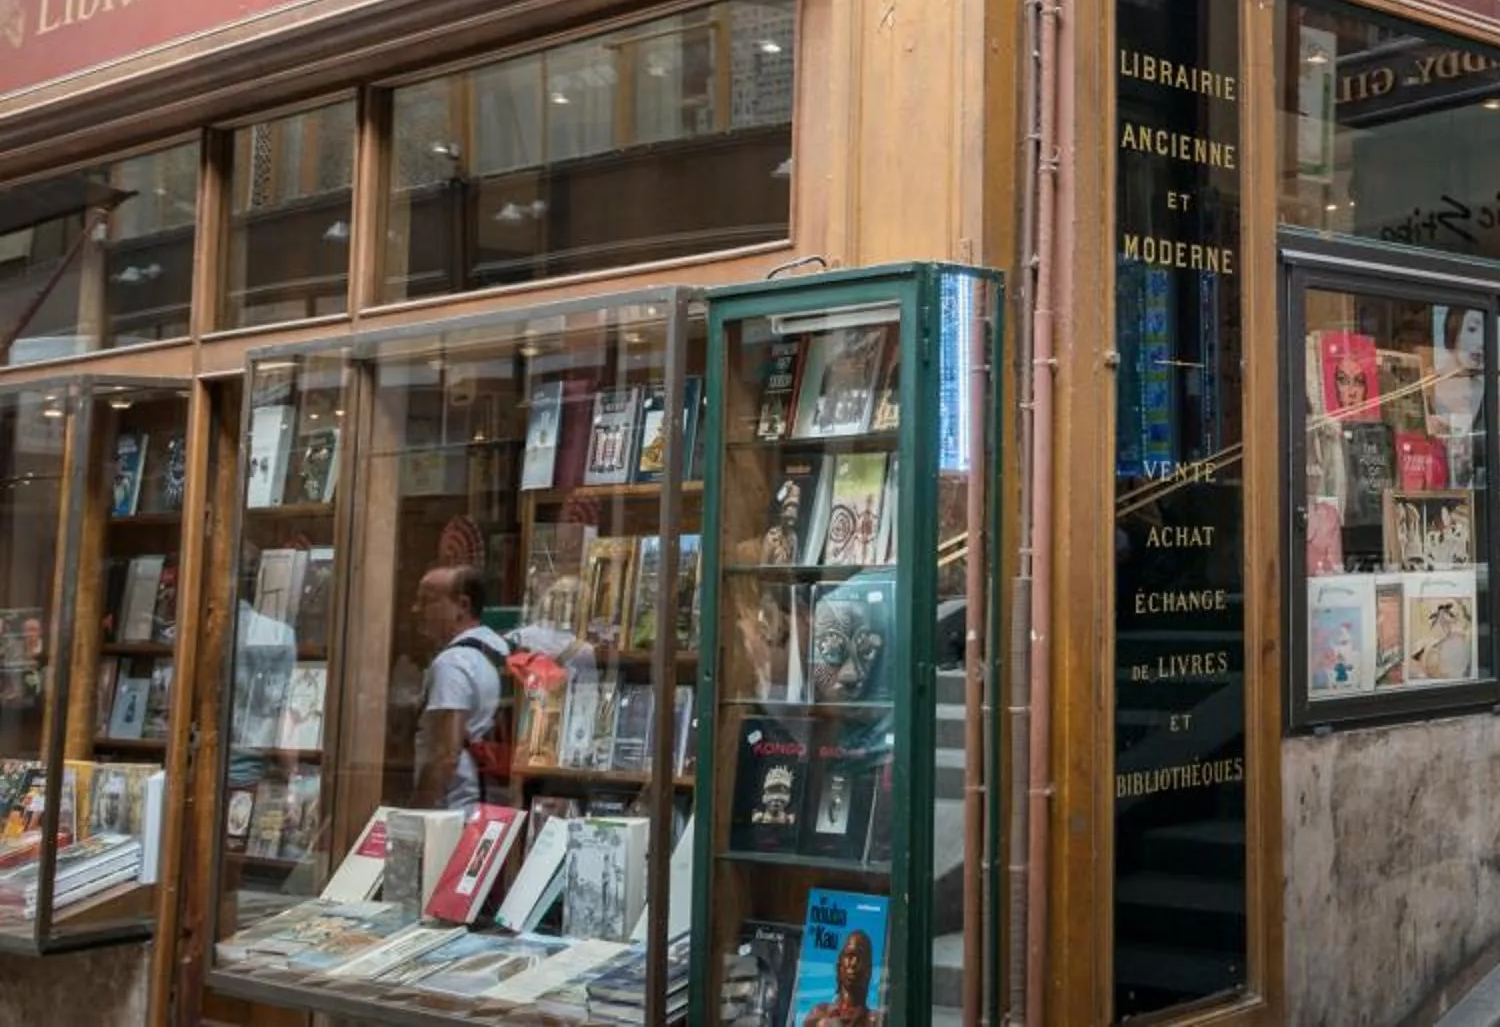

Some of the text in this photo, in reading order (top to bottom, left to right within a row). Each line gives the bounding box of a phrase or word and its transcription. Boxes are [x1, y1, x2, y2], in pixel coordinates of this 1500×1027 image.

[1120, 49, 1237, 101] LIBRAIRIE
[1120, 123, 1237, 170] ANCIENNE
[1167, 191, 1194, 212] ET
[1123, 234, 1233, 274] MODERNE
[1142, 459, 1217, 483] VENTE
[1146, 525, 1215, 549] ACHAT
[1135, 589, 1226, 615] ÉCHANGE
[1131, 652, 1229, 681] DE LIVRES
[1169, 714, 1192, 733] ET
